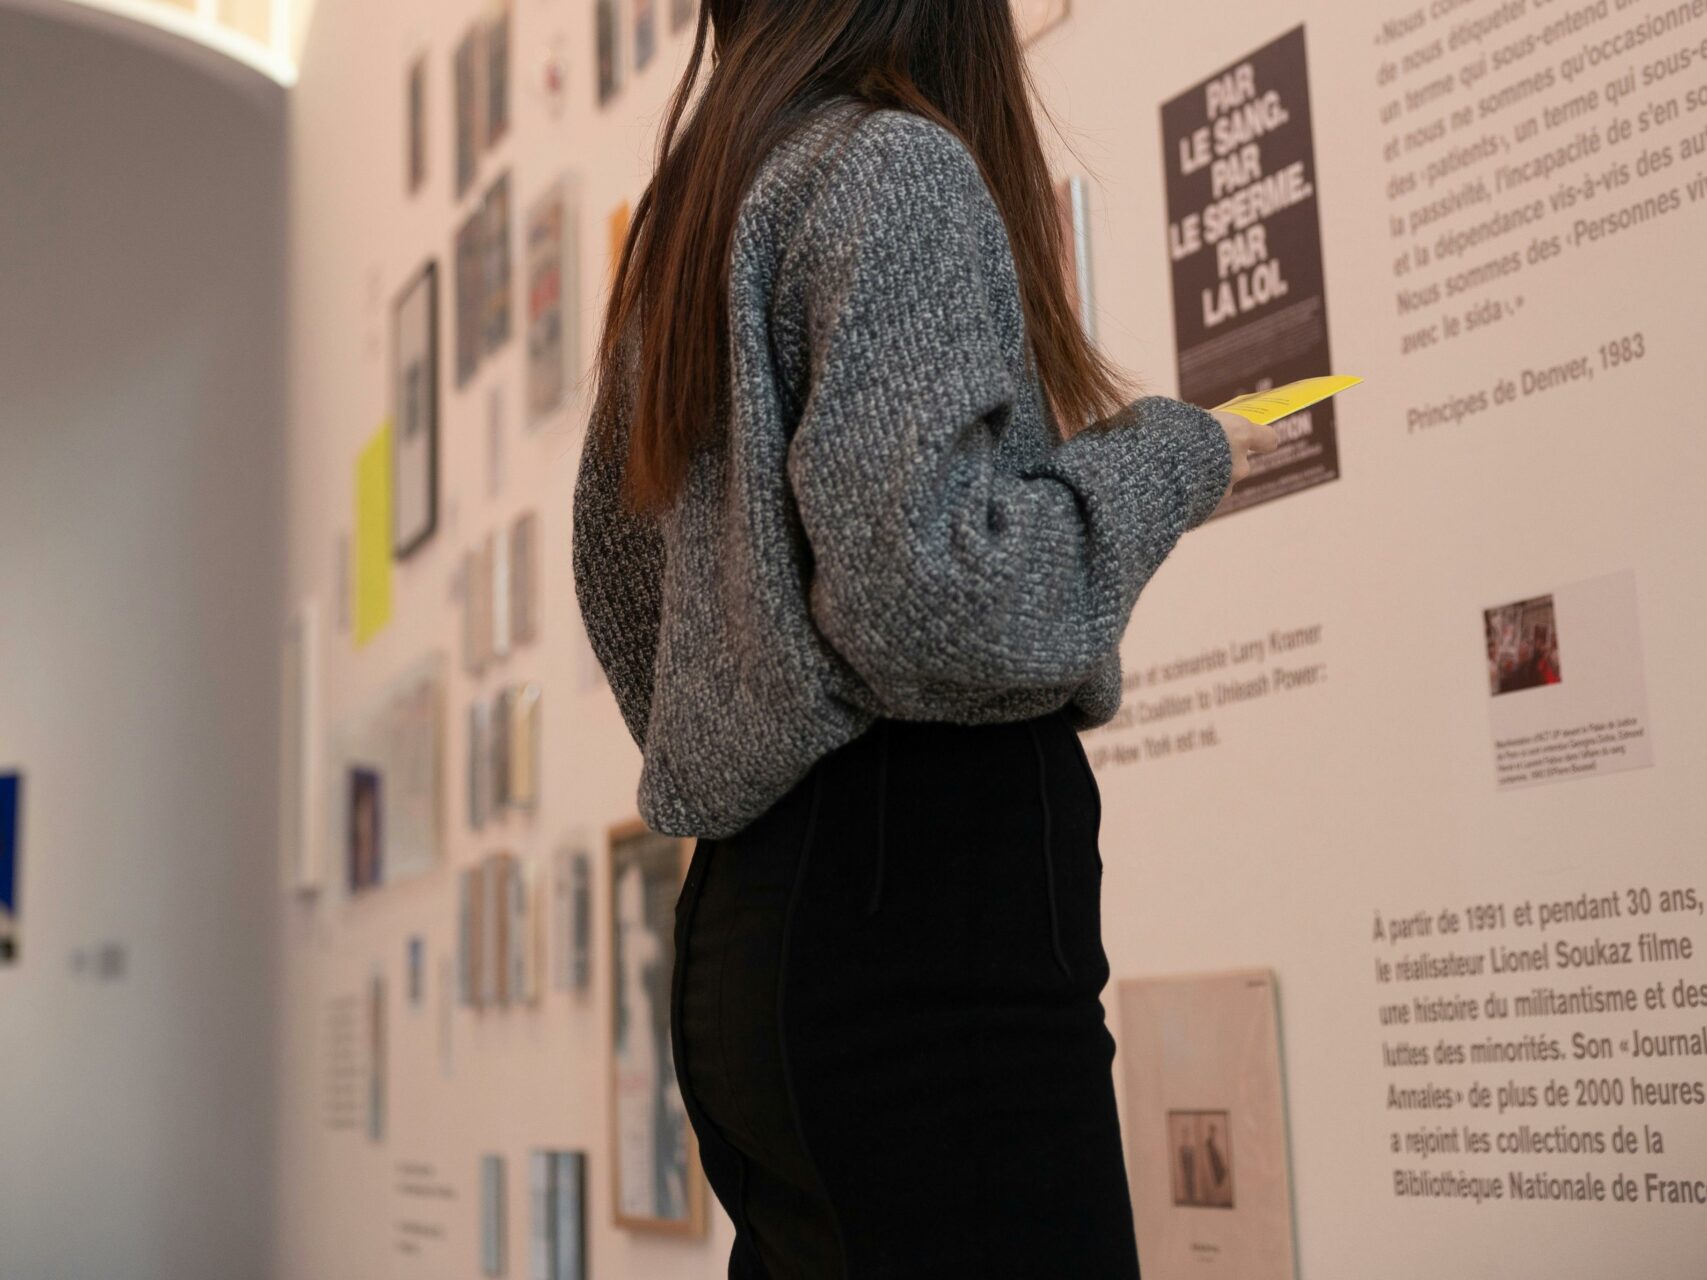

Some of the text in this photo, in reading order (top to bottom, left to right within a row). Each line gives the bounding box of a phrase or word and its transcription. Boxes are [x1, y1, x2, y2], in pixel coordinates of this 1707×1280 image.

[1204, 61, 1257, 122] PAR
[1377, 61, 1398, 88] de
[1402, 38, 1443, 74] nous
[1380, 99, 1401, 126] un
[1405, 73, 1455, 113] terme
[1459, 52, 1487, 89] qui
[1178, 89, 1291, 177] LE SANG.
[1383, 136, 1400, 163] et
[1404, 117, 1448, 152] nous
[1450, 105, 1475, 132] ne
[1477, 66, 1556, 119] sommes
[1387, 170, 1417, 201] des
[1513, 117, 1540, 144] un
[1543, 89, 1600, 131] terme
[1604, 64, 1637, 107] qui
[1210, 141, 1263, 200] PAR
[1389, 214, 1406, 238] la
[1495, 125, 1601, 194] l'incapacité
[1606, 116, 1634, 147] de
[1637, 98, 1680, 134] s'en
[1168, 159, 1315, 263] LE SPERME.
[1393, 250, 1411, 278] et
[1413, 243, 1431, 269] la
[1434, 198, 1546, 260] dépendance
[1549, 161, 1632, 214] vis-à-vis
[1636, 149, 1675, 179] des
[1215, 222, 1269, 280] PAR
[1397, 283, 1442, 317] Nous
[1445, 250, 1523, 298] sommes
[1526, 234, 1562, 267] des
[1201, 279, 1238, 329] LA
[1401, 323, 1441, 356] avec
[1442, 313, 1461, 340] le
[1405, 331, 1647, 434] Principes de Denver, 1983
[1268, 623, 1323, 655] Kramer
[1372, 885, 1704, 946] À partir de 1991 et pendant 30 ans,
[1375, 931, 1694, 984] le réalisateur Lionel Soukaz filme
[1379, 978, 1707, 1026] une histoire du militantisme et des
[1382, 1040, 1430, 1068] luttes
[1433, 1038, 1466, 1066] des
[1470, 1032, 1567, 1065] minorités.
[1572, 1031, 1614, 1061] Son
[1468, 1081, 1492, 1109] de
[1497, 1078, 1539, 1114] plus
[1544, 1078, 1570, 1108] de
[1575, 1077, 1626, 1108] 2000
[1631, 1076, 1706, 1106] heures
[1390, 1124, 1665, 1160] a rejoint les collections de la
[1393, 1169, 1707, 1205] Bibliothèque Nationale de Franc
